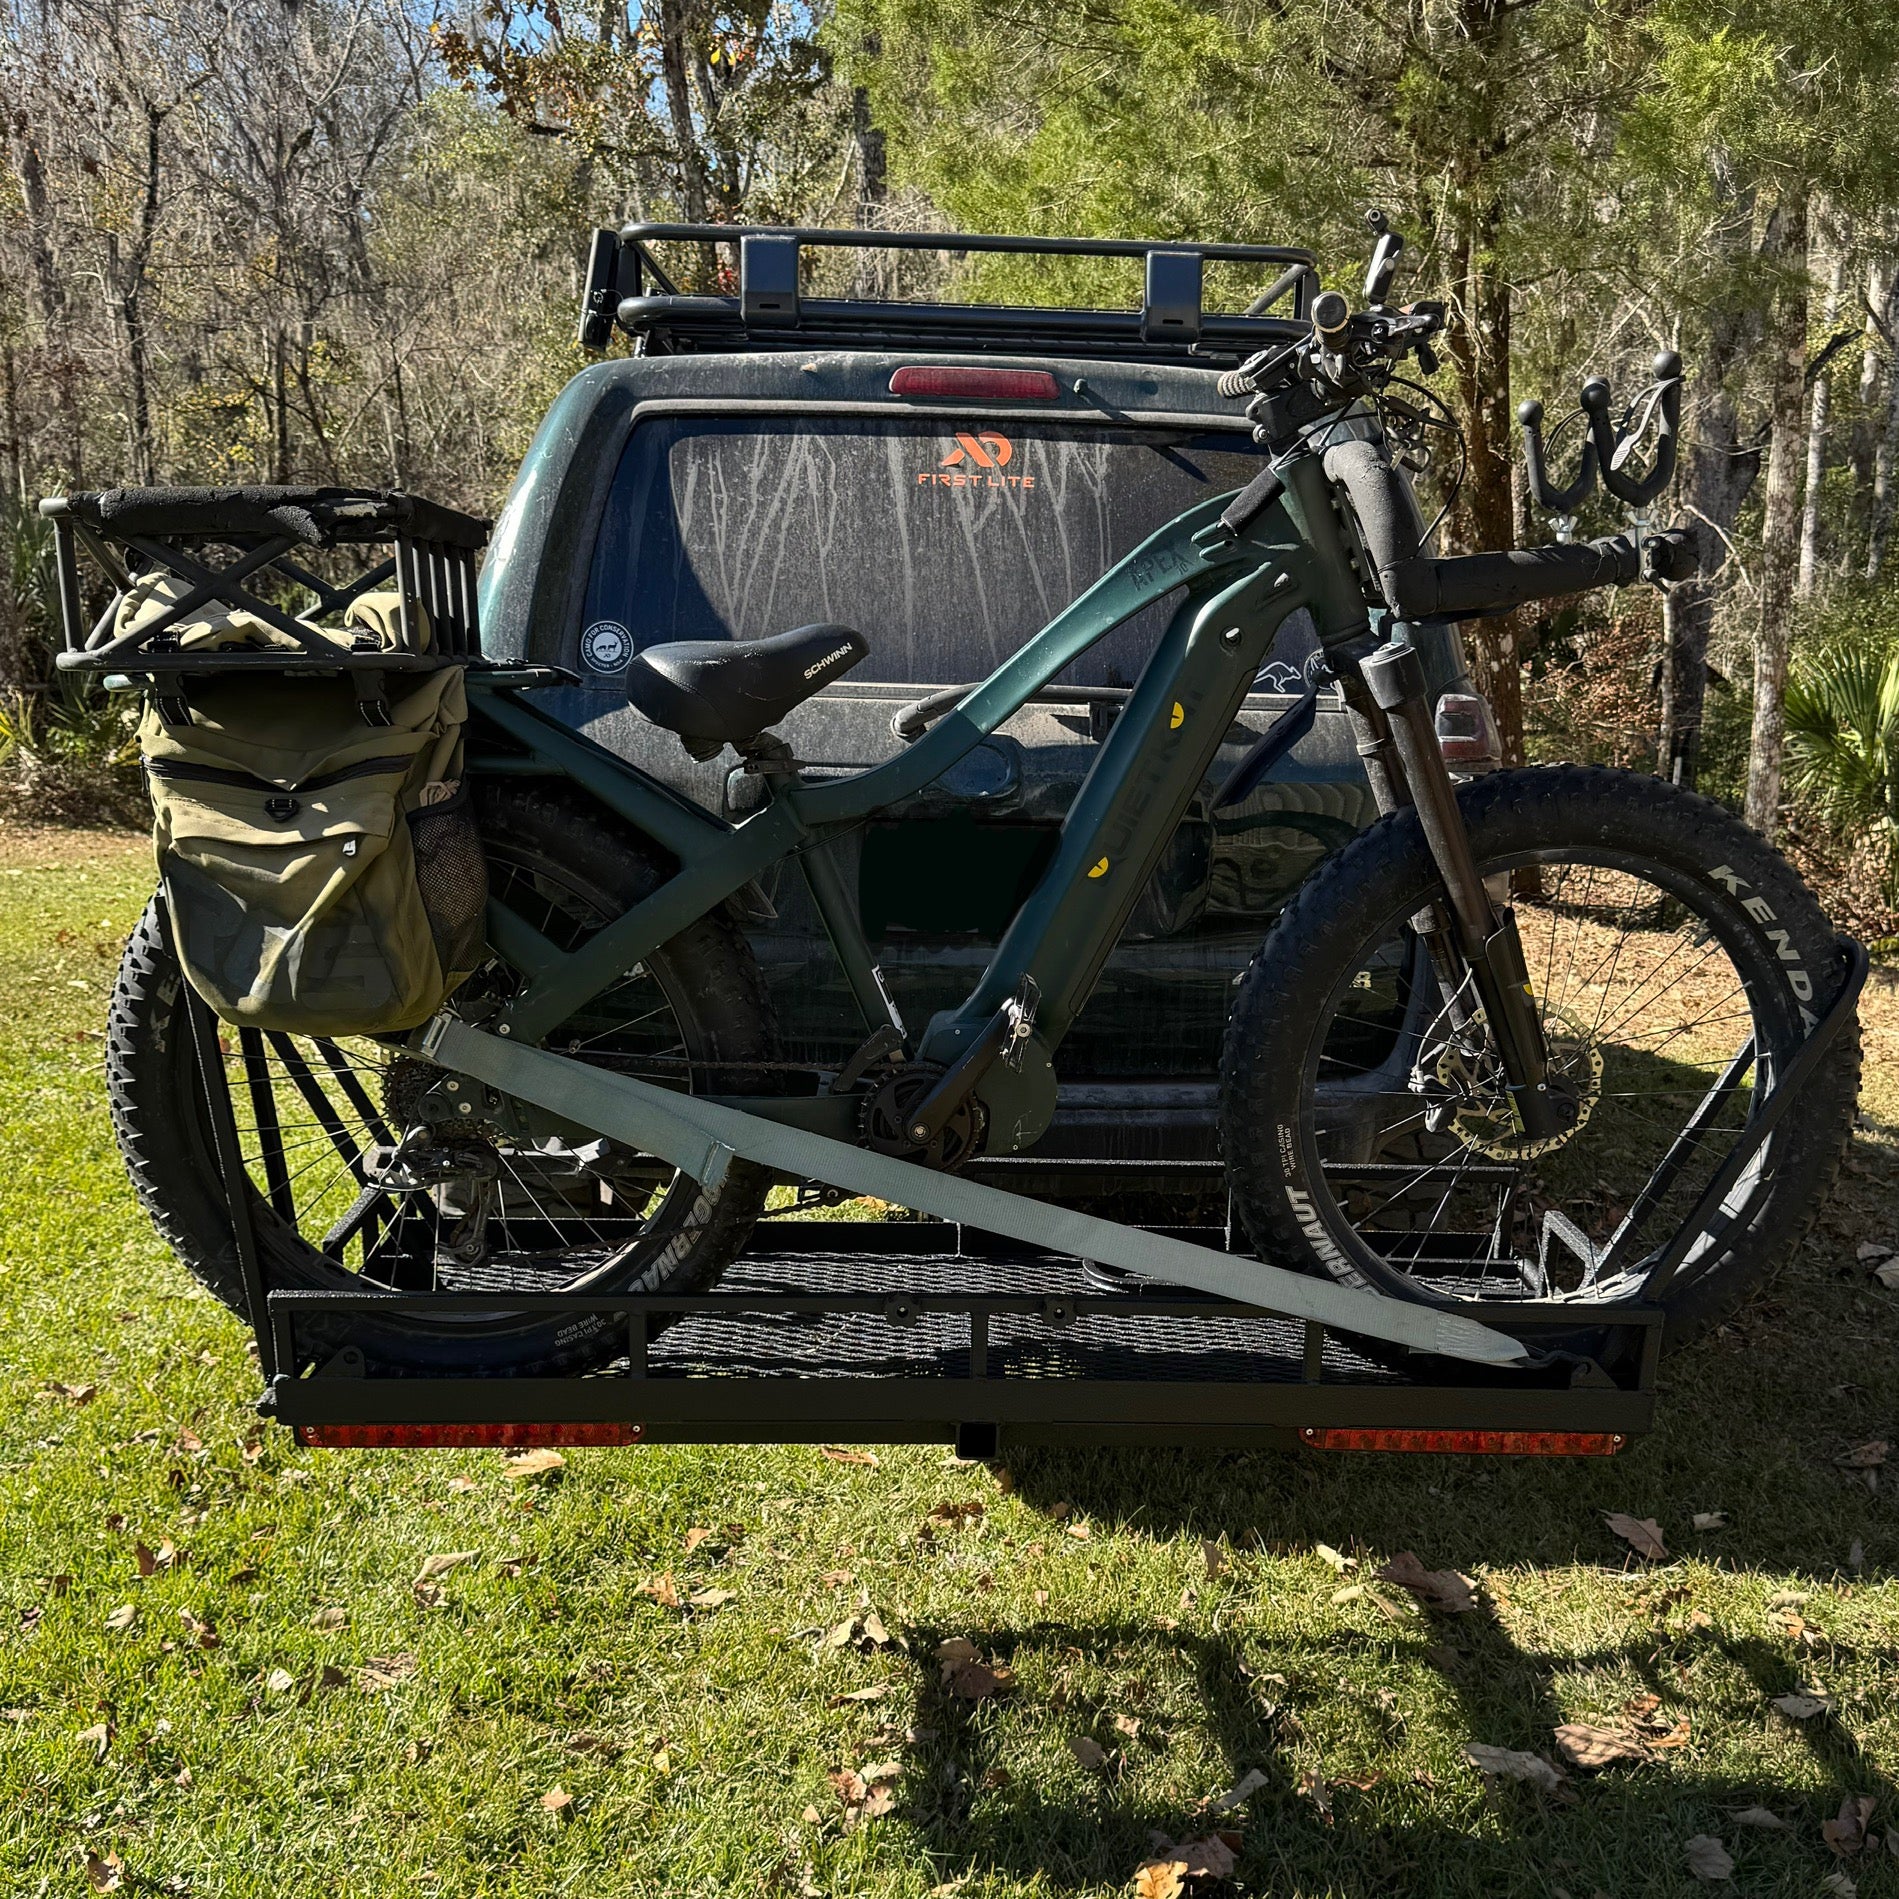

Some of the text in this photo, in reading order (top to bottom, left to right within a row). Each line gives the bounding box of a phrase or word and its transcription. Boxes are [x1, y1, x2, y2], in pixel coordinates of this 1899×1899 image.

[918, 474, 1035, 488] FIRST LITE
[804, 642, 853, 680] SCHWINN
[1707, 865, 1821, 1041] KENDA
[1285, 1128, 1297, 1171] WIRE BEAD
[577, 1313, 599, 1328] WIRE
